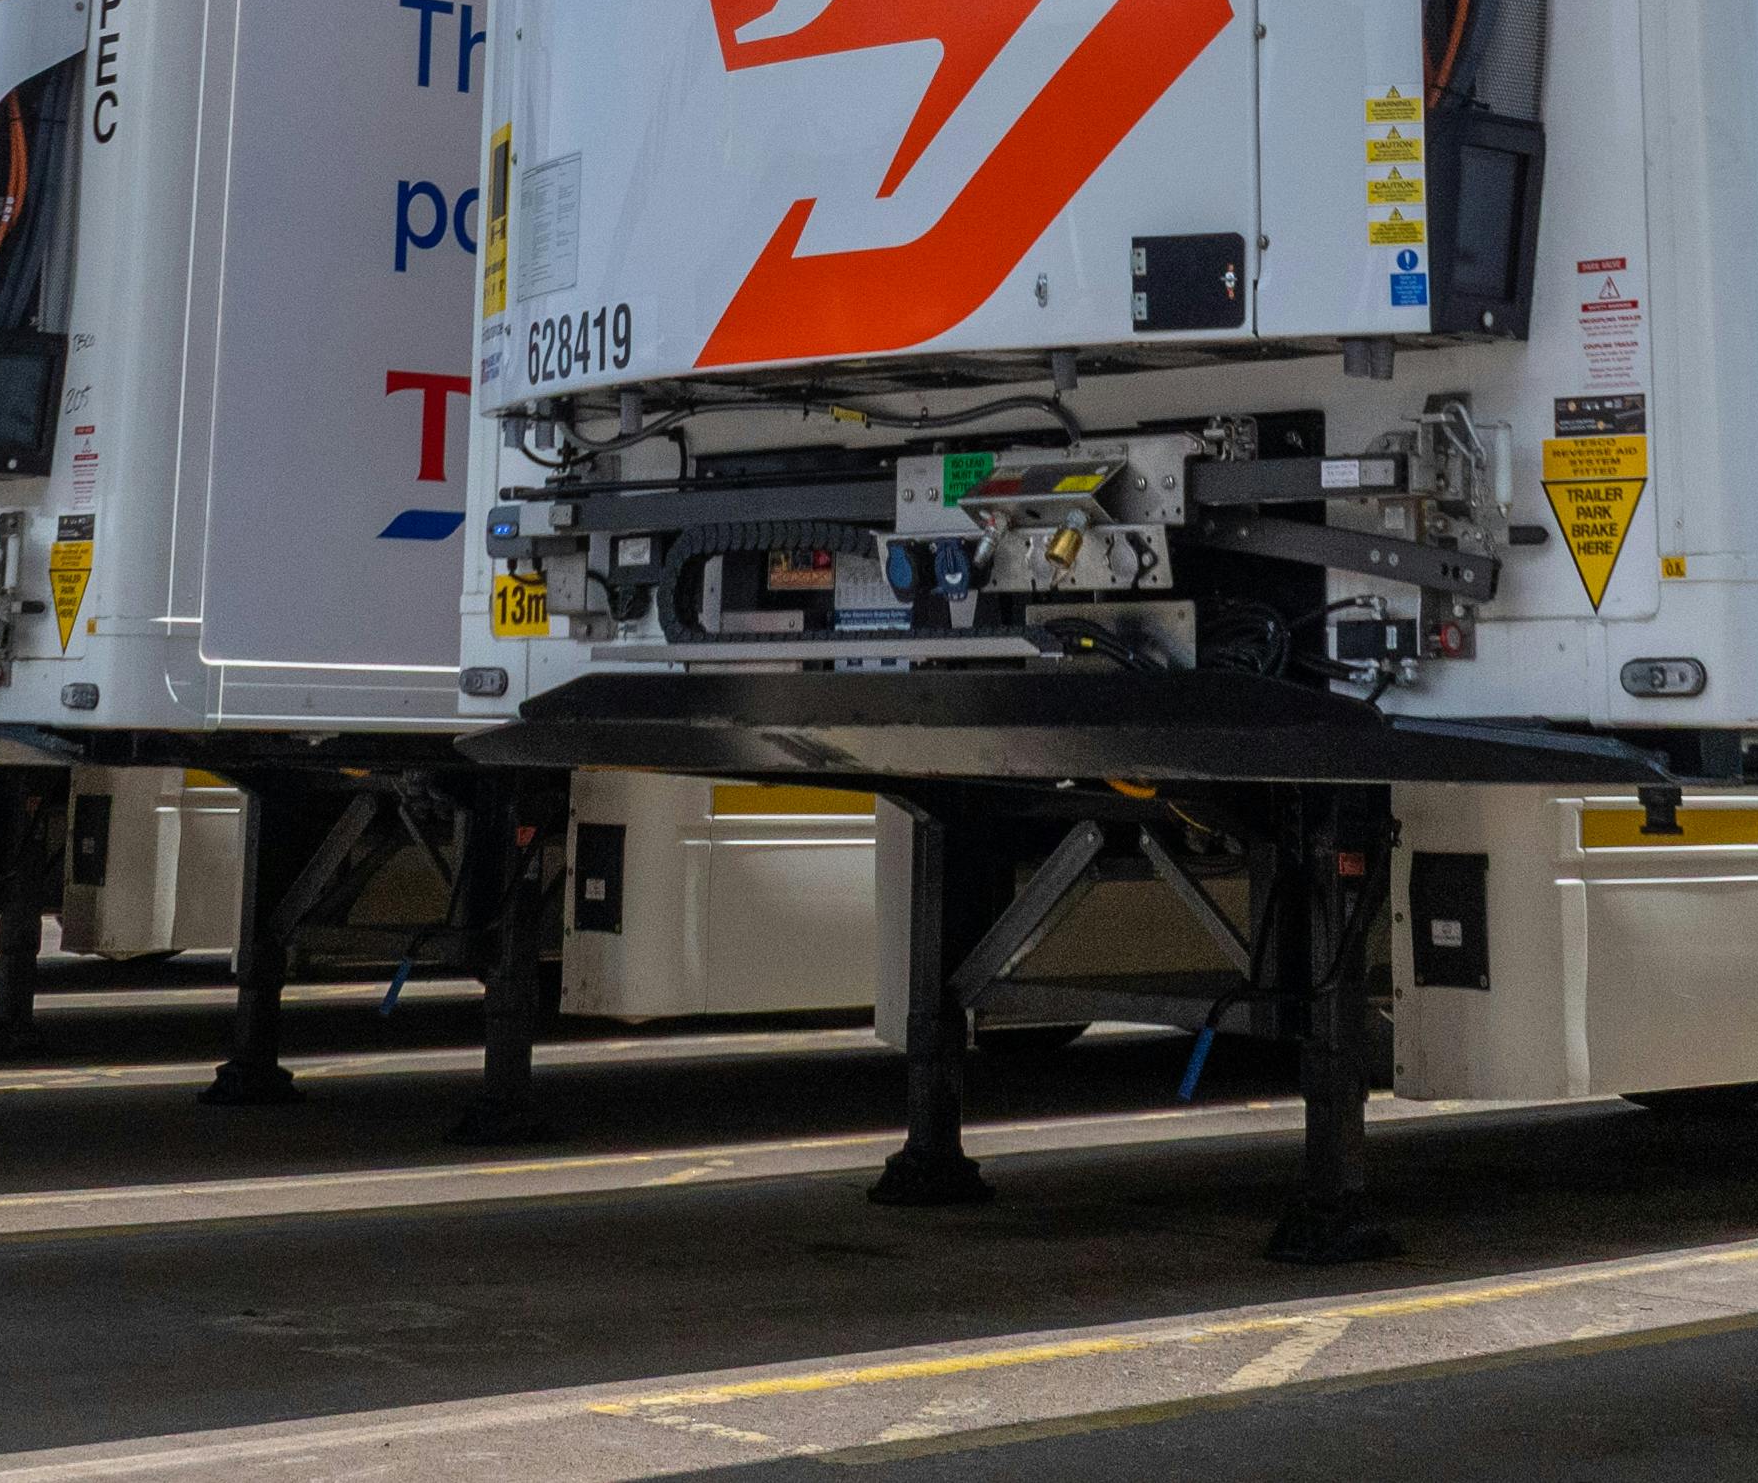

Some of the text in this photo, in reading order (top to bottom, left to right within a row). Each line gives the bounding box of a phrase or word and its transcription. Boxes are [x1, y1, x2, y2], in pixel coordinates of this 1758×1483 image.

[528, 303, 632, 385] 628419
[1566, 486, 1623, 504] TRAILER
[1576, 505, 1612, 520] PARK
[1571, 522, 1618, 539] BRAKE
[1576, 540, 1614, 556] HERE
